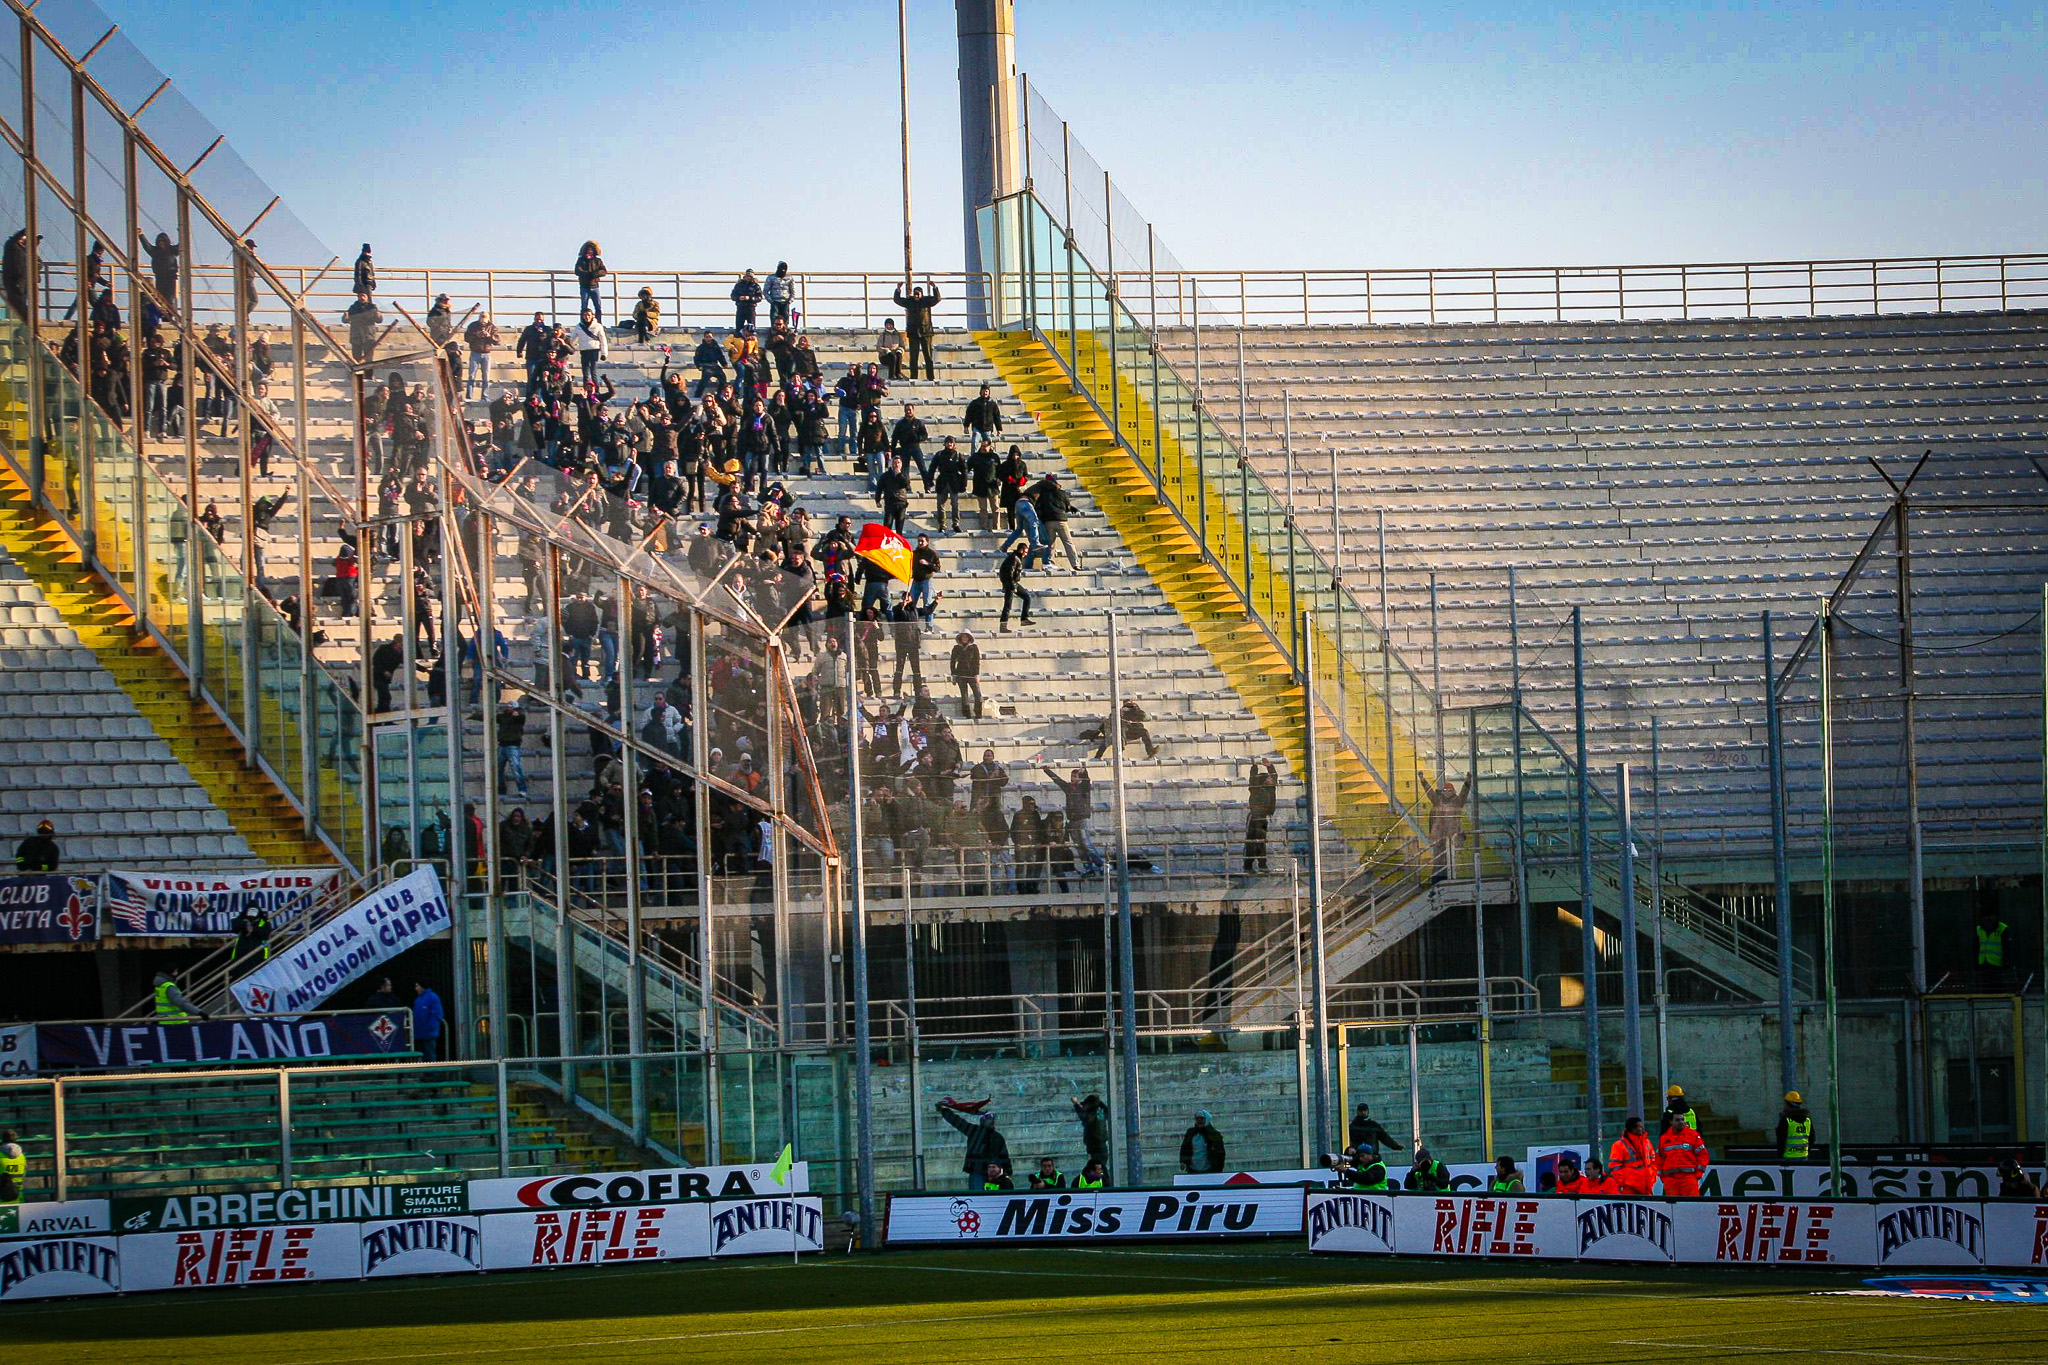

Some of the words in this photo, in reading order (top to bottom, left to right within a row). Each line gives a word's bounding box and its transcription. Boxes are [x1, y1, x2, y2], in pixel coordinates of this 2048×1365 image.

[0, 885, 50, 905] CLUB
[142, 879, 231, 892] VIOLA
[240, 876, 313, 889] CLUB
[155, 893, 192, 931] SAN
[293, 923, 359, 970] VIOLA
[365, 888, 414, 925] CLUB
[286, 940, 377, 1012] ANTOGNONI
[379, 896, 447, 947] CAPRI
[84, 1022, 331, 1066] VELLANO
[159, 1186, 394, 1229] ARREGHINI
[400, 1185, 462, 1196] PITTURE
[405, 1196, 458, 1206] SMALTI
[550, 1169, 756, 1206] COFRA
[996, 1195, 1122, 1236] Miss
[1139, 1191, 1259, 1232] Piru
[26, 1216, 97, 1234] ARVAL
[362, 1219, 480, 1276] ANTIFIT
[532, 1207, 667, 1265] RIFLE
[712, 1200, 822, 1253] ANTIFIT
[1309, 1197, 1393, 1251] ANTIFIT
[1433, 1199, 1536, 1254] RIFLE
[1578, 1202, 1673, 1258] ANTIFIT
[1716, 1203, 1834, 1262] RIFLE
[1878, 1205, 1982, 1263] ANTIFIT
[0, 1240, 118, 1297] ANTIFIT
[174, 1227, 314, 1286] RIFLE
